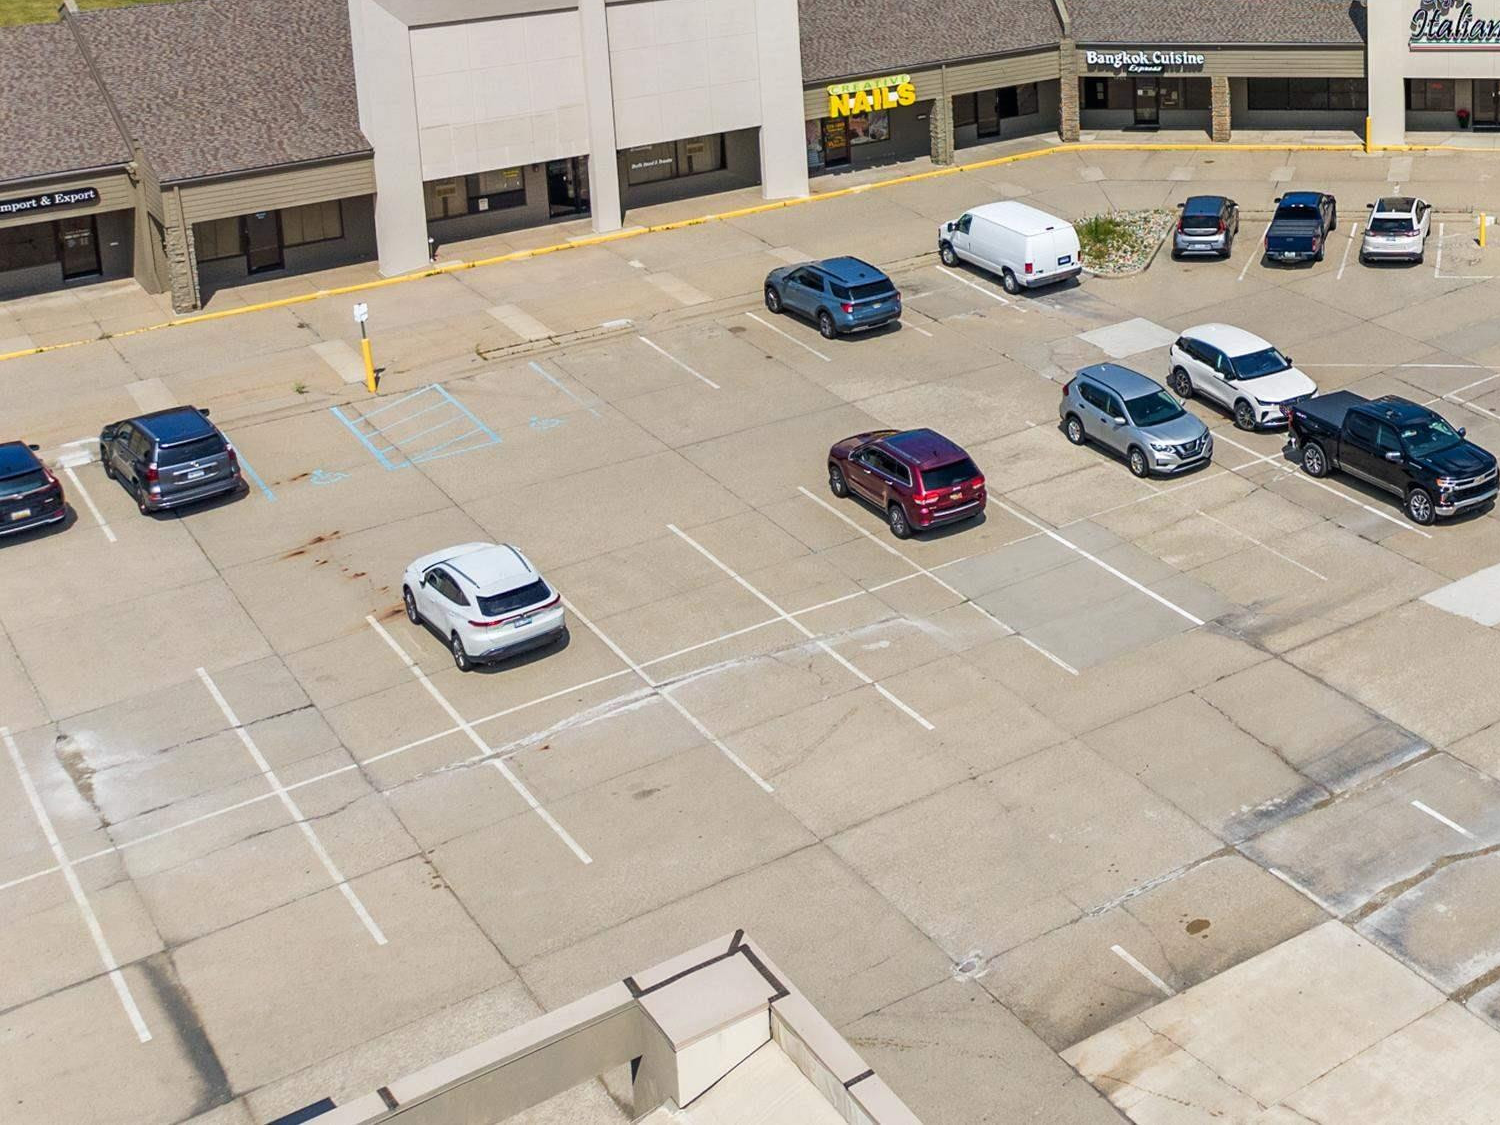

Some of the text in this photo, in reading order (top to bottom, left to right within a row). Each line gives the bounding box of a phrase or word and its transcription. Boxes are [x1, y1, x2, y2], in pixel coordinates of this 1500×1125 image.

[1086, 50, 1205, 68] Bangkok Cuisine
[1128, 64, 1163, 73] Express
[830, 74, 908, 94] CREATIVE
[828, 82, 916, 119] NAILS
[40, 195, 51, 207] &
[54, 190, 96, 204] Export
